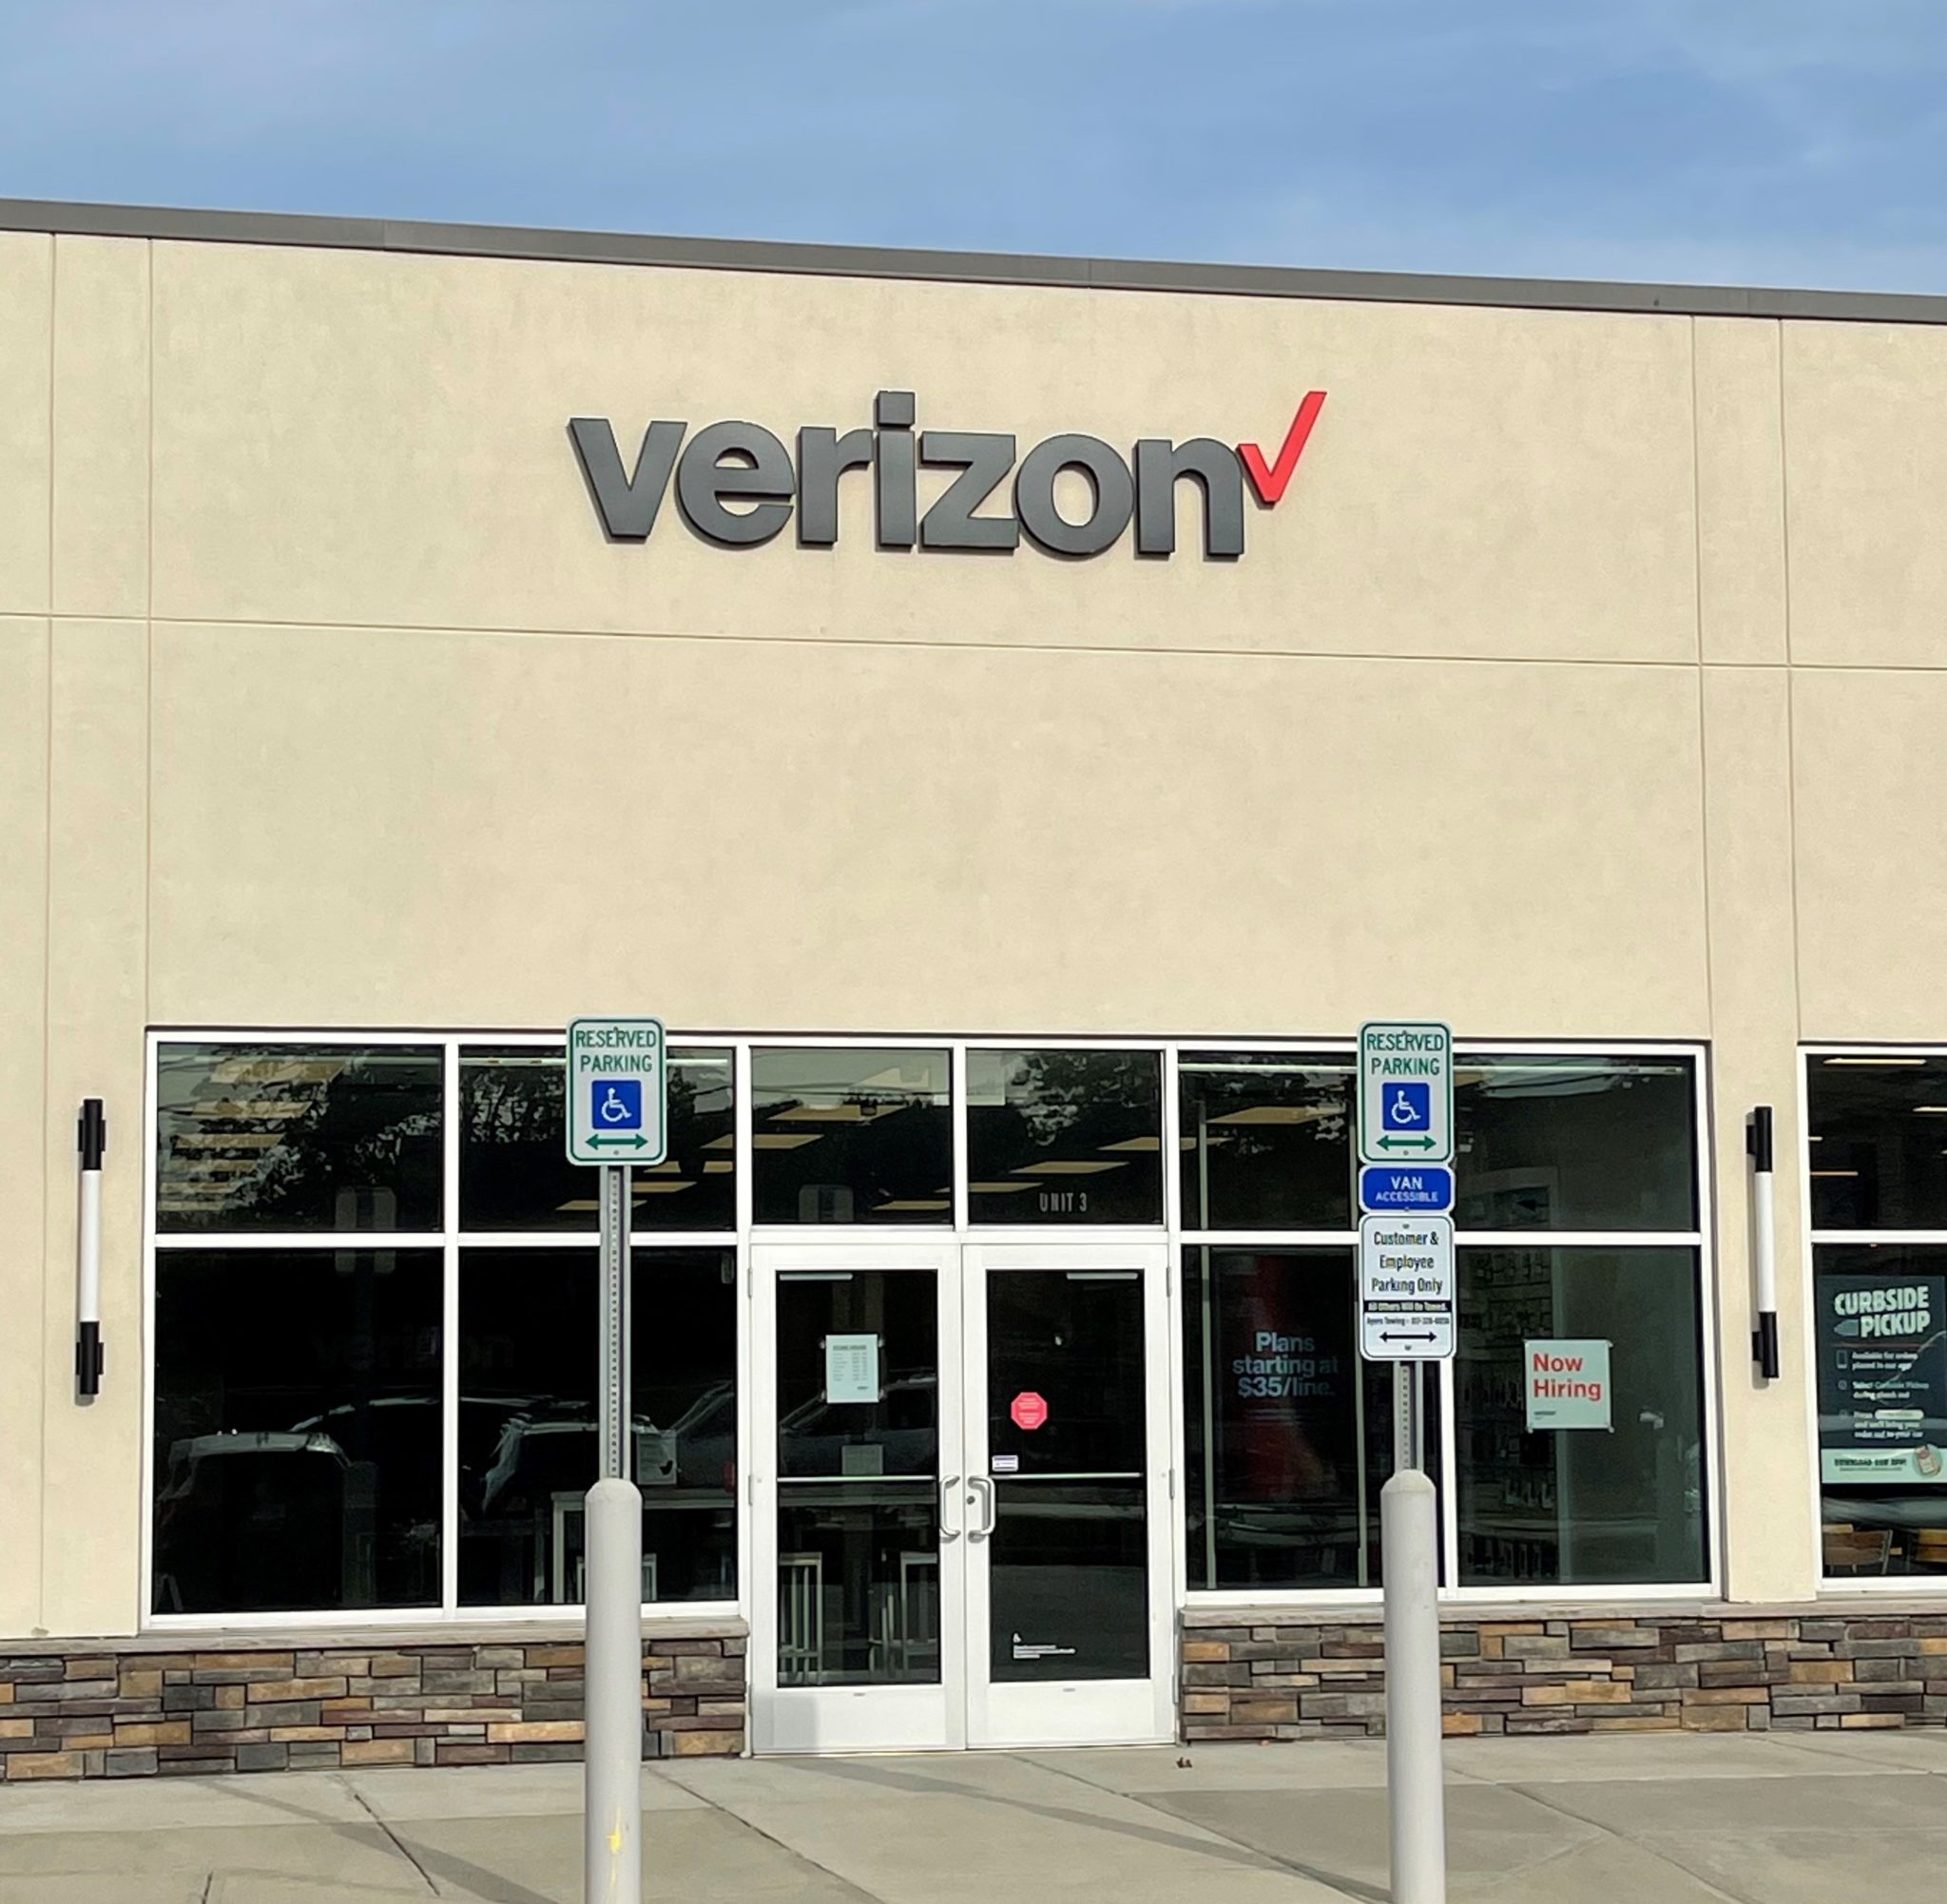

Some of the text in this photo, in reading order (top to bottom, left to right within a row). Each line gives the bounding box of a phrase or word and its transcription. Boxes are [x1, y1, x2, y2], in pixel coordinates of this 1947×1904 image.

[568, 391, 1244, 556] verizon
[575, 1029, 657, 1048] RESERVED
[1366, 1032, 1444, 1051] RESERVED
[580, 1054, 653, 1072] PARKING
[1371, 1057, 1440, 1075] PARKING
[1390, 1176, 1423, 1190] VAN
[1039, 1192, 1088, 1212] UNIT 3
[1375, 1191, 1439, 1202] ACCESSIBLE
[1374, 1231, 1439, 1245] Customer &
[1379, 1254, 1435, 1272] Employee
[1371, 1278, 1443, 1296] Parking Only
[1834, 1285, 1930, 1316] CURBSIDE
[1860, 1310, 1931, 1338] PICKUP
[1256, 1332, 1315, 1352] Plans
[1232, 1355, 1339, 1378] starting at
[1533, 1354, 1583, 1372] Now
[1533, 1379, 1601, 1402] Hiring
